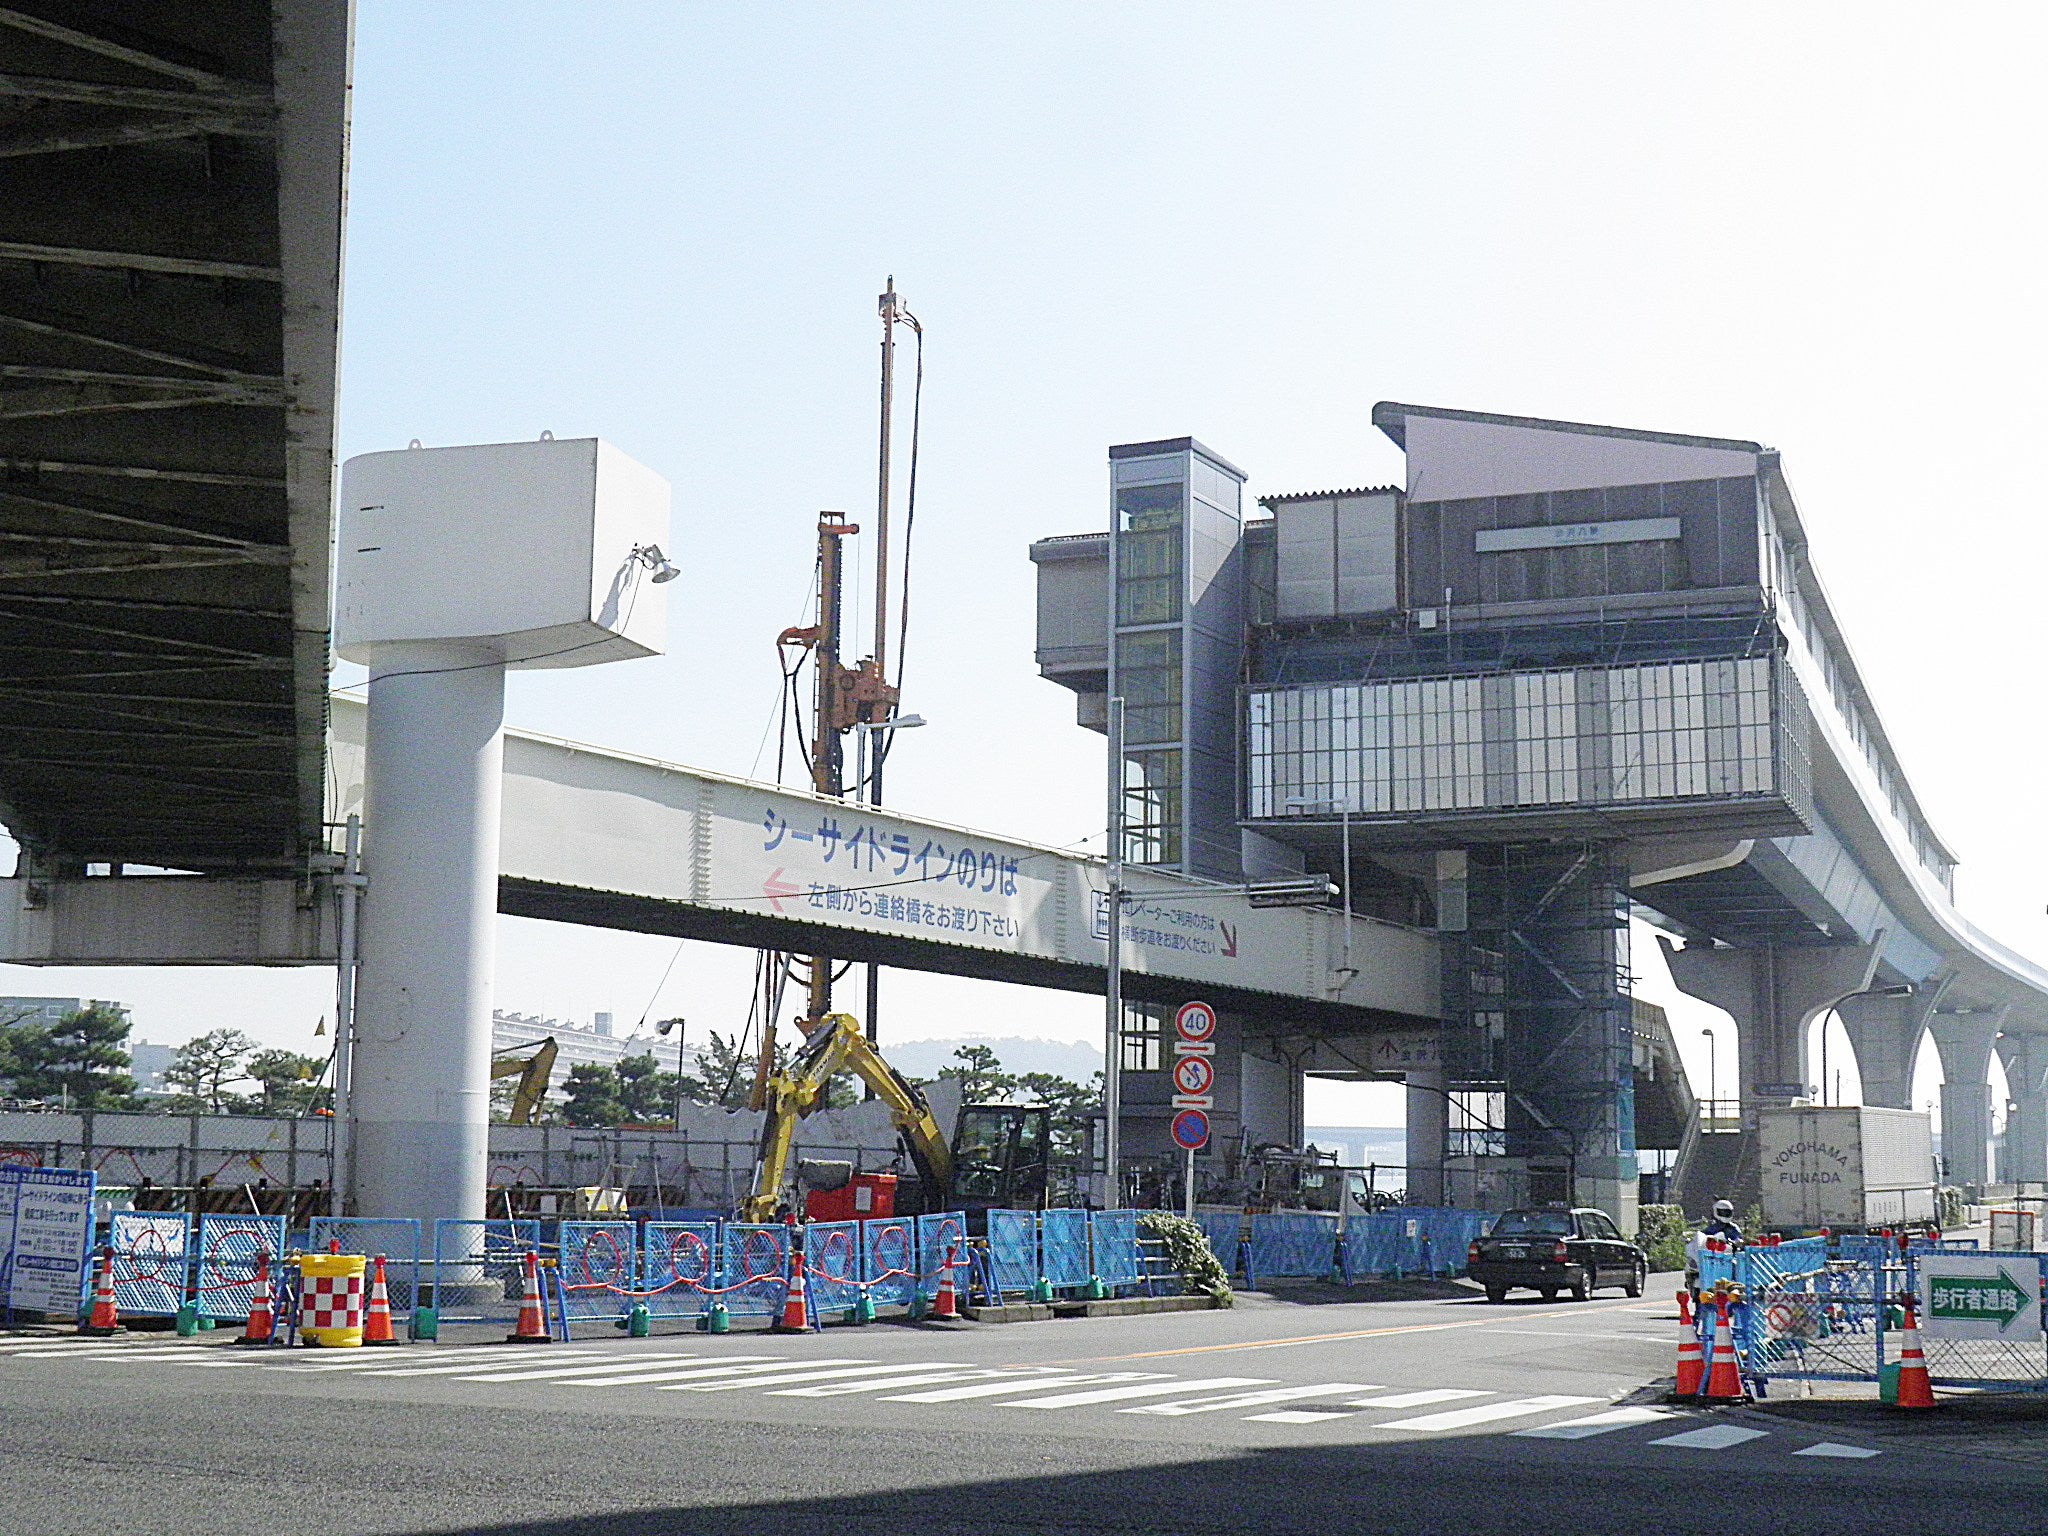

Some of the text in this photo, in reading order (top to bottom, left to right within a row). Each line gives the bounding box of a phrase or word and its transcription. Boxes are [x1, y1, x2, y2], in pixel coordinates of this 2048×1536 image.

[764, 808, 1018, 897] シーサイドラインのりば
[808, 881, 1019, 938] 左側から連絡橋をお渡り下さい
[1122, 925, 1216, 954] 横断歩道をお渡りください
[1185, 1013, 1207, 1031] 40
[1772, 1141, 1849, 1169] YOKOHAMA
[1779, 1172, 1841, 1184] FUNADA
[1933, 1286, 2018, 1312] 歩行者通路
